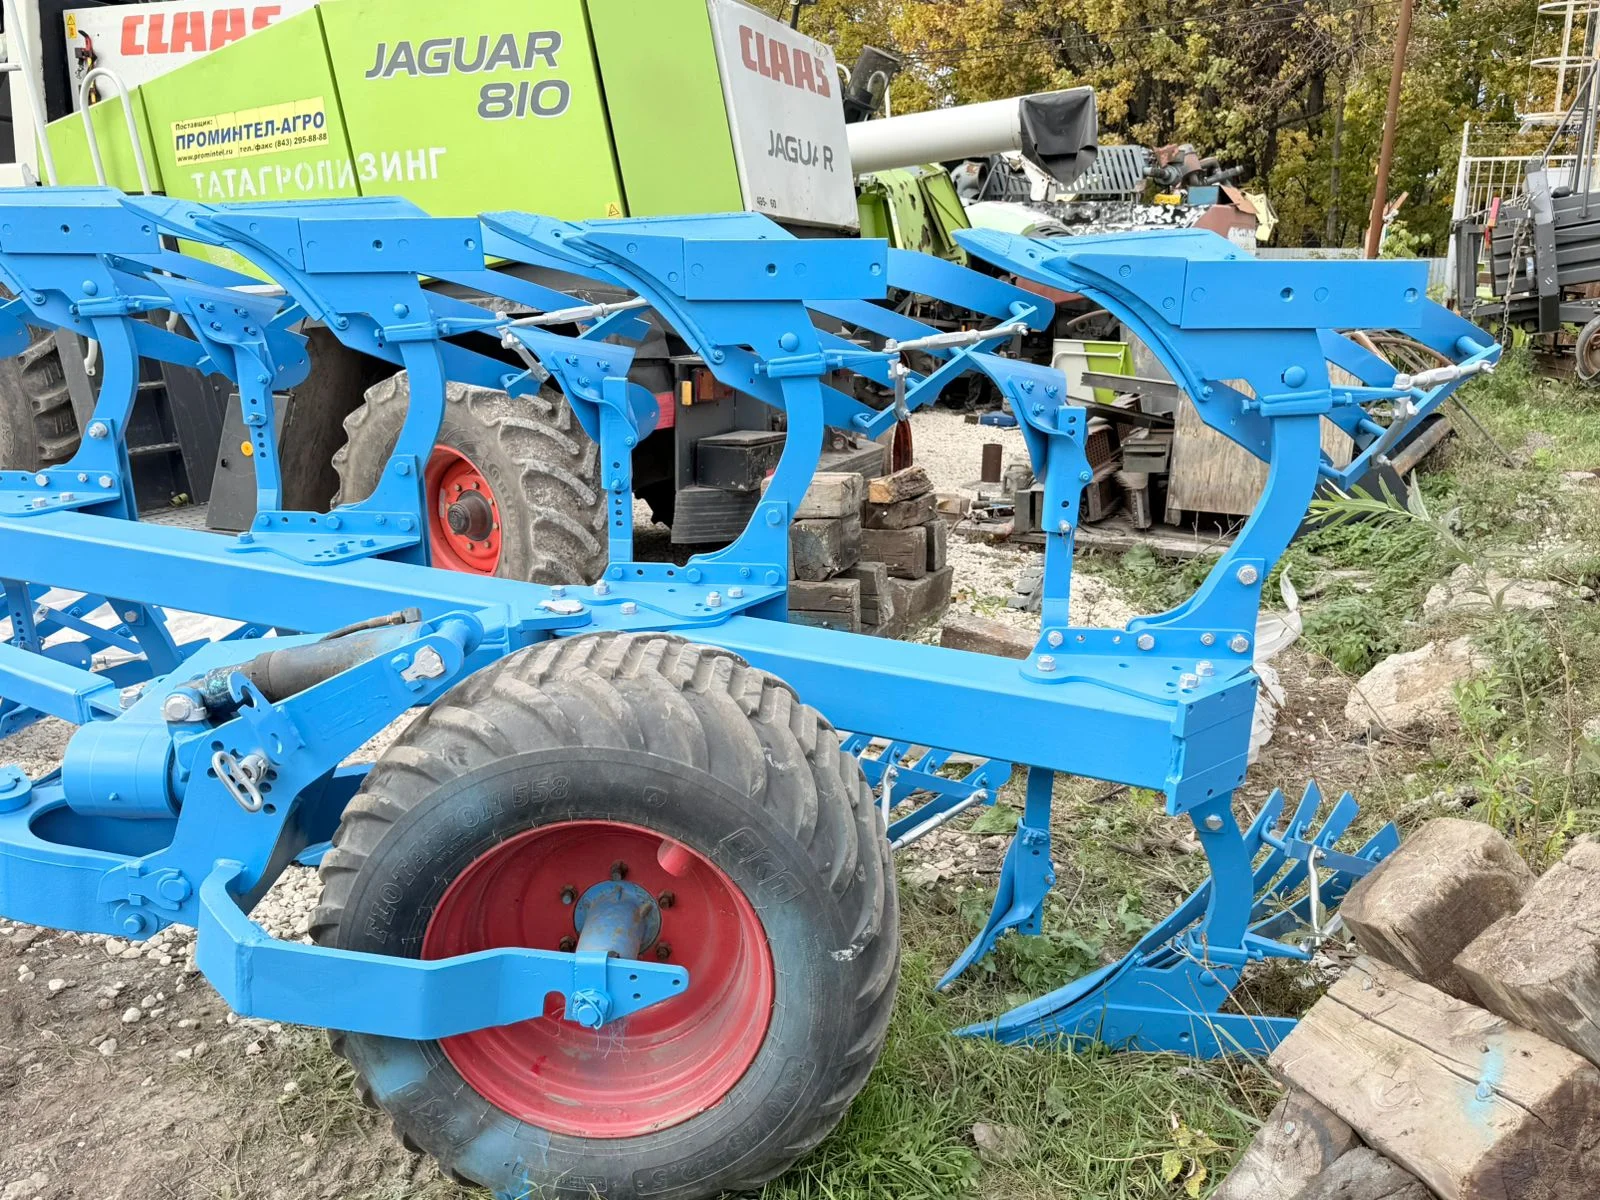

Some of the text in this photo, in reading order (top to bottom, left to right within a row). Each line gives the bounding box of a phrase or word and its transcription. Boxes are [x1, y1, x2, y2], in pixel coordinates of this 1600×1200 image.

[365, 30, 562, 80] JAGUAR
[739, 25, 831, 98] CLAAS
[477, 79, 571, 120] 810
[175, 119, 213, 131] Поставщик:
[176, 111, 325, 151] ПРОМИНТЕЛ-АГРО
[177, 149, 233, 162] www.promintel.ru
[274, 138, 292, 150] (843)
[511, 775, 570, 809] 558
